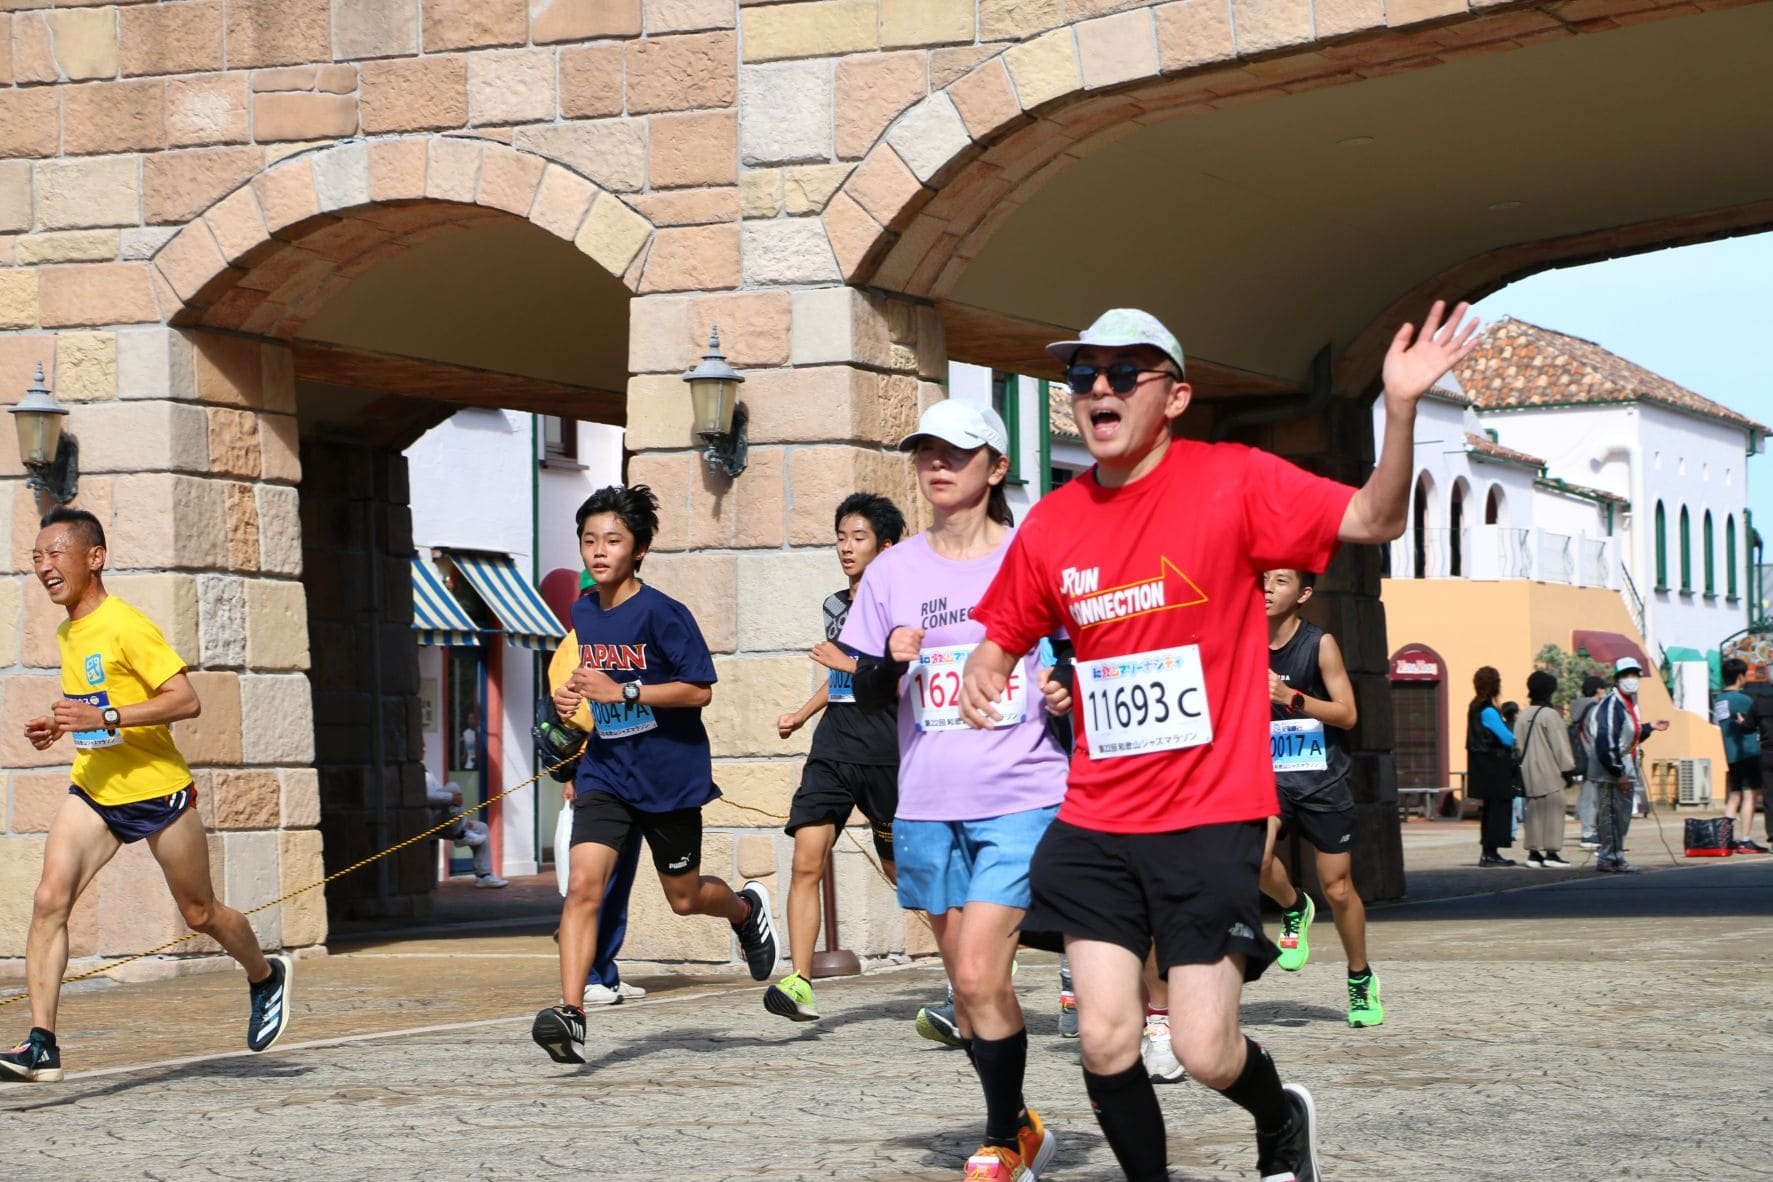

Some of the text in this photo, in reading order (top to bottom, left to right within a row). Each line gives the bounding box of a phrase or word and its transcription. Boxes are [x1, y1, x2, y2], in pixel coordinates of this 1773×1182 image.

[1060, 567, 1099, 598] RUN
[921, 597, 948, 617] RUN
[1088, 681, 1202, 732] 11693 C
[1310, 740, 1322, 756] A
